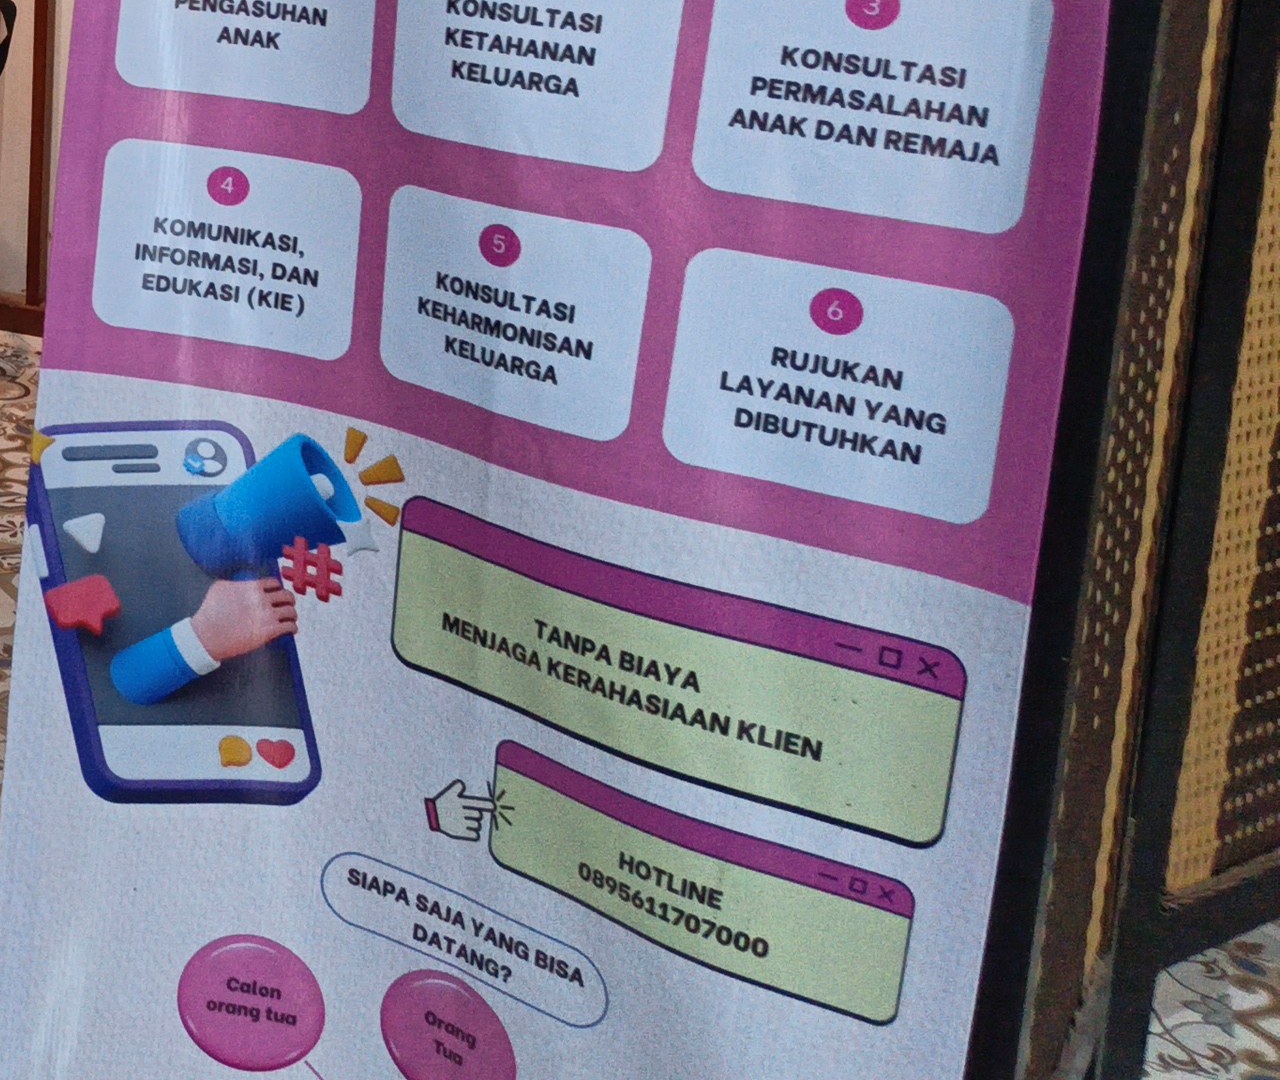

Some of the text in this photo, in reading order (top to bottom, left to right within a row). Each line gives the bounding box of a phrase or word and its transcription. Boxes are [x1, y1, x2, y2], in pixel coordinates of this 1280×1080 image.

[216, 26, 281, 51] ANAK
[444, 28, 597, 67] KETAHANAN
[450, 59, 580, 98] KELUARGA
[780, 45, 968, 89] KONSULTASI
[749, 76, 990, 128] PERMASALAHAN
[728, 107, 1001, 166] ANAK DAN REMAJA
[220, 176, 235, 194] 4
[153, 216, 306, 259] KOMUNIKASI,
[492, 234, 507, 255] 5
[135, 243, 320, 288] INFORMASI, DAN
[141, 272, 306, 318] EDUKASI (KIE)
[435, 270, 577, 324] KONSULTASI
[826, 300, 844, 321] 6
[417, 296, 594, 361] KEHARMONISAN
[444, 335, 559, 386] KELUARGA
[771, 346, 904, 391] RUJUKAN
[719, 370, 947, 436] LAYANAN YANG
[733, 407, 923, 465] DIBUTUHKAN
[533, 617, 702, 694] TANPA BIAYA
[441, 611, 823, 762] MENJAGA KERAHASIAAN KLIEN
[618, 851, 724, 911] HOTLINE
[347, 867, 586, 988] SIAPA SAJA YANG BISA
[578, 862, 769, 958] 0895611707000
[412, 923, 513, 984] DATANG?
[226, 976, 282, 1001] Calon
[206, 998, 298, 1027] orang tua
[423, 1009, 477, 1051] Orang
[433, 1039, 465, 1067] Tua
